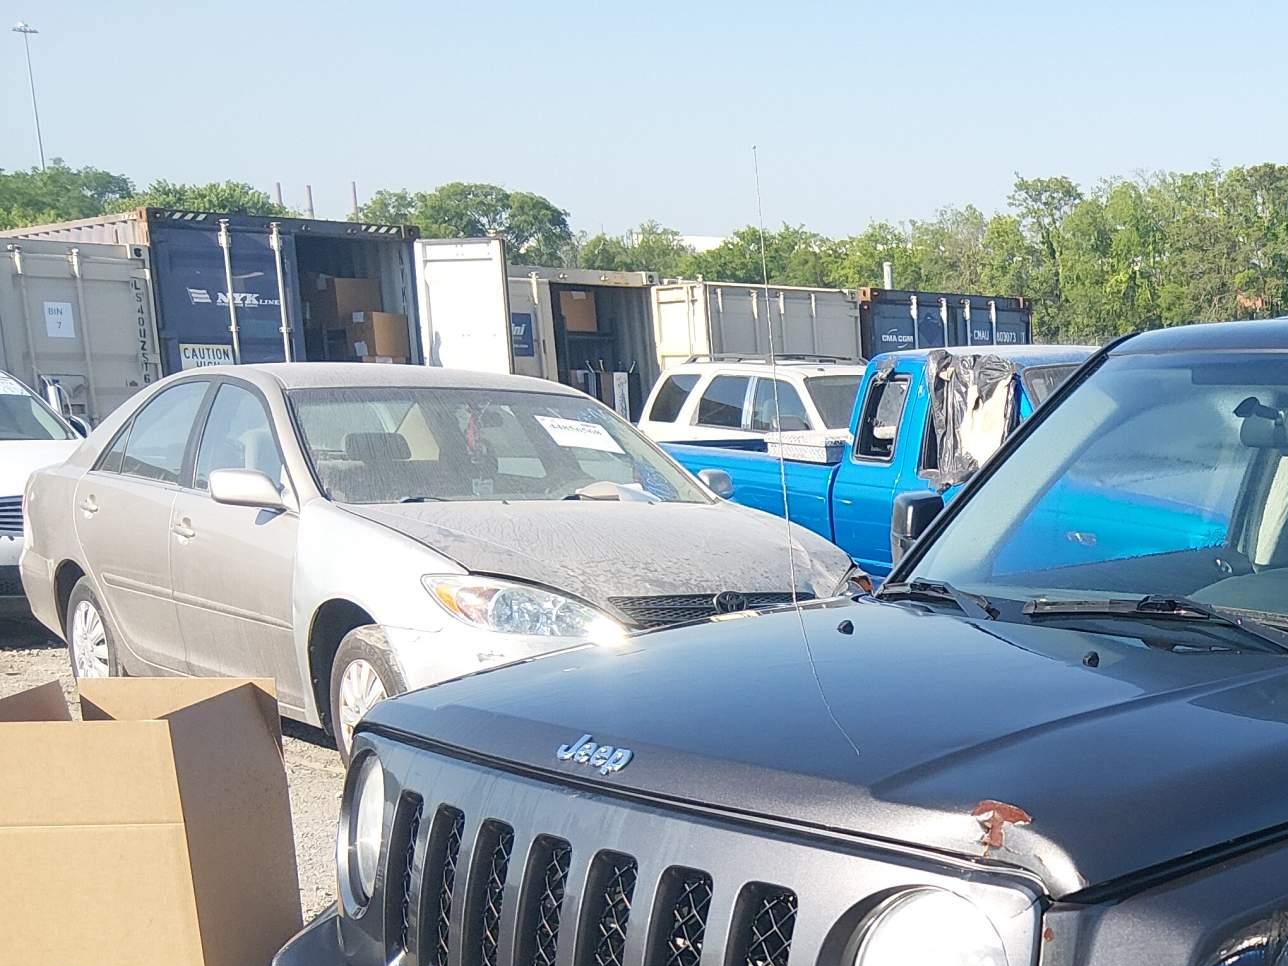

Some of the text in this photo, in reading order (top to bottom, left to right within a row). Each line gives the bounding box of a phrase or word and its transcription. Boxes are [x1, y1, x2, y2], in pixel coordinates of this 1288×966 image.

[216, 292, 259, 307] NYK
[48, 307, 63, 316] BIN
[56, 321, 62, 329] 7
[882, 334, 914, 343] CMA CGM
[183, 347, 230, 361] CAUTION
[556, 734, 633, 776] Jeep
